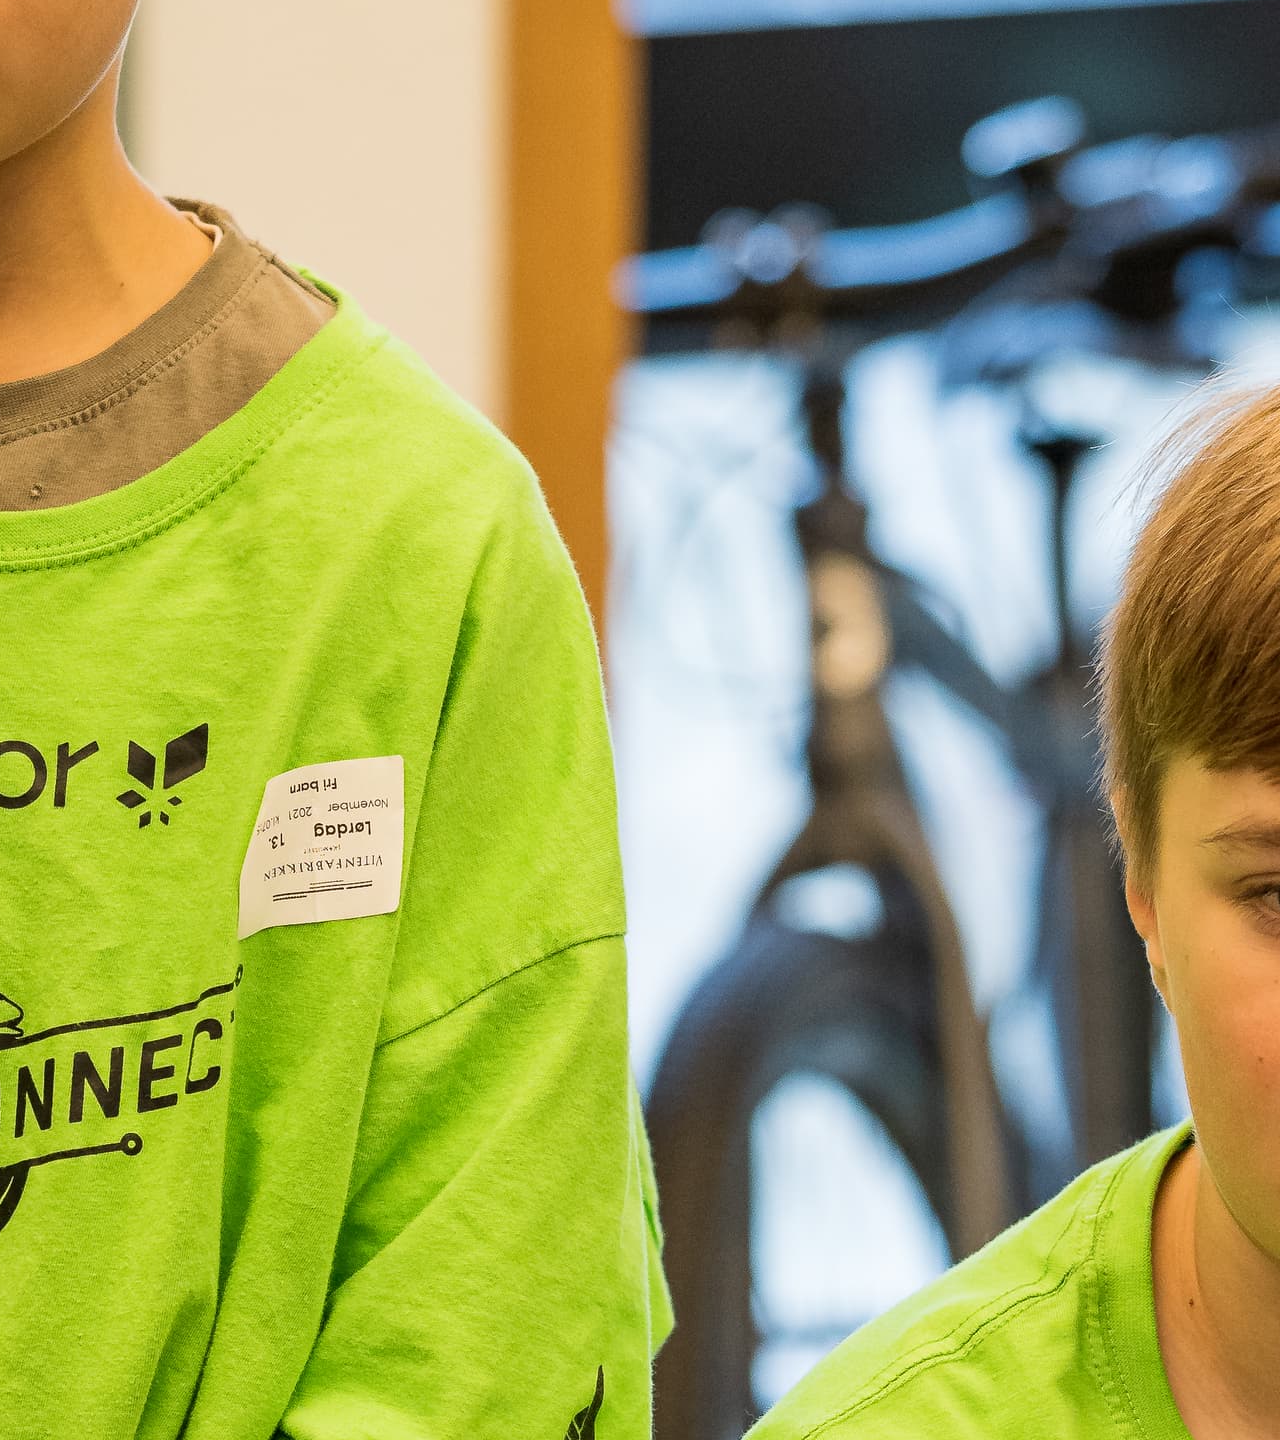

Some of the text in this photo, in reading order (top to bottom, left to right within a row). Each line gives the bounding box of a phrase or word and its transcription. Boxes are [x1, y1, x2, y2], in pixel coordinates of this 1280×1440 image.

[289, 778, 338, 794] Fri barn
[288, 806, 313, 821] 2021
[327, 798, 389, 813] November
[313, 820, 372, 839] Lørdag
[268, 832, 285, 850] 13.
[263, 855, 384, 881] VITENFABRIKKEN
